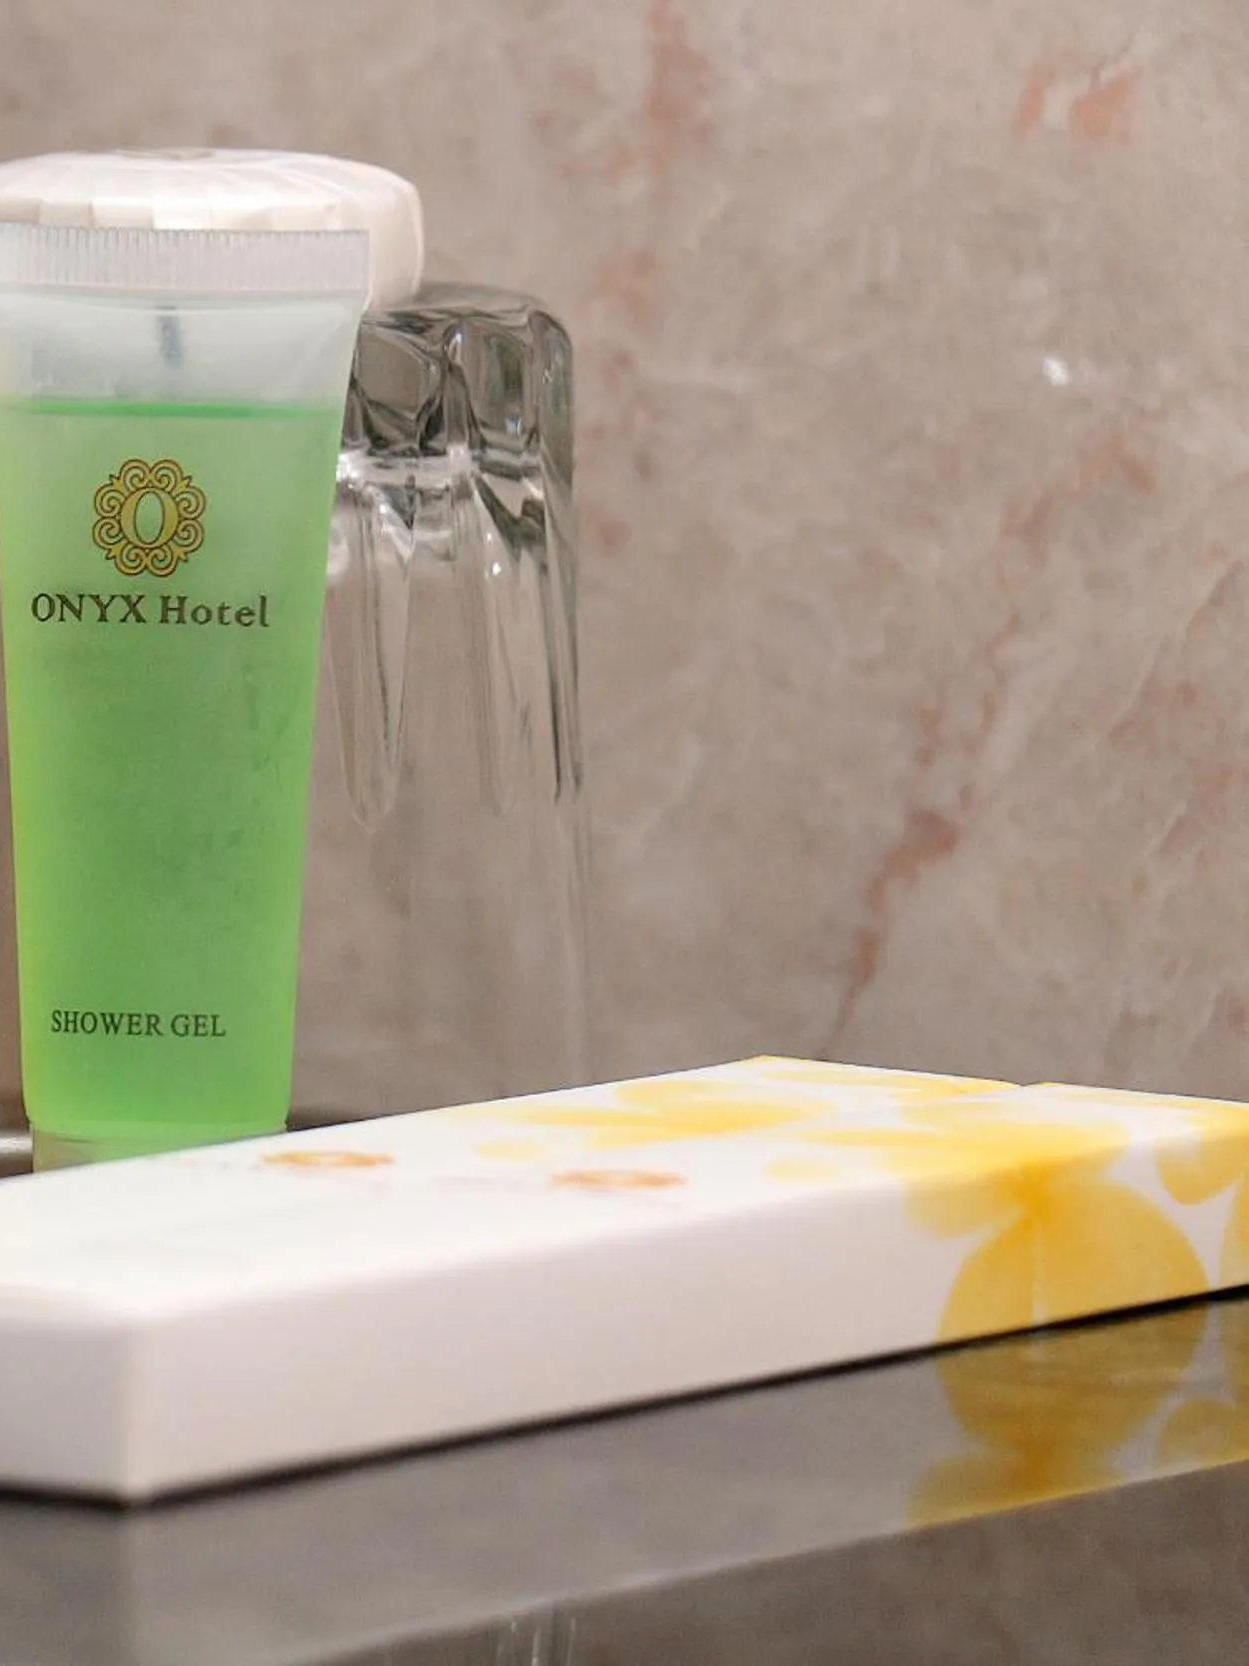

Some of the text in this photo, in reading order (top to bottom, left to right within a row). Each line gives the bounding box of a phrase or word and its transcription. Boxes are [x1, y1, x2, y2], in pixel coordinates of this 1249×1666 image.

[31, 592, 269, 628] ONYX Hotel
[51, 1010, 227, 1038] SHOWER GEL
